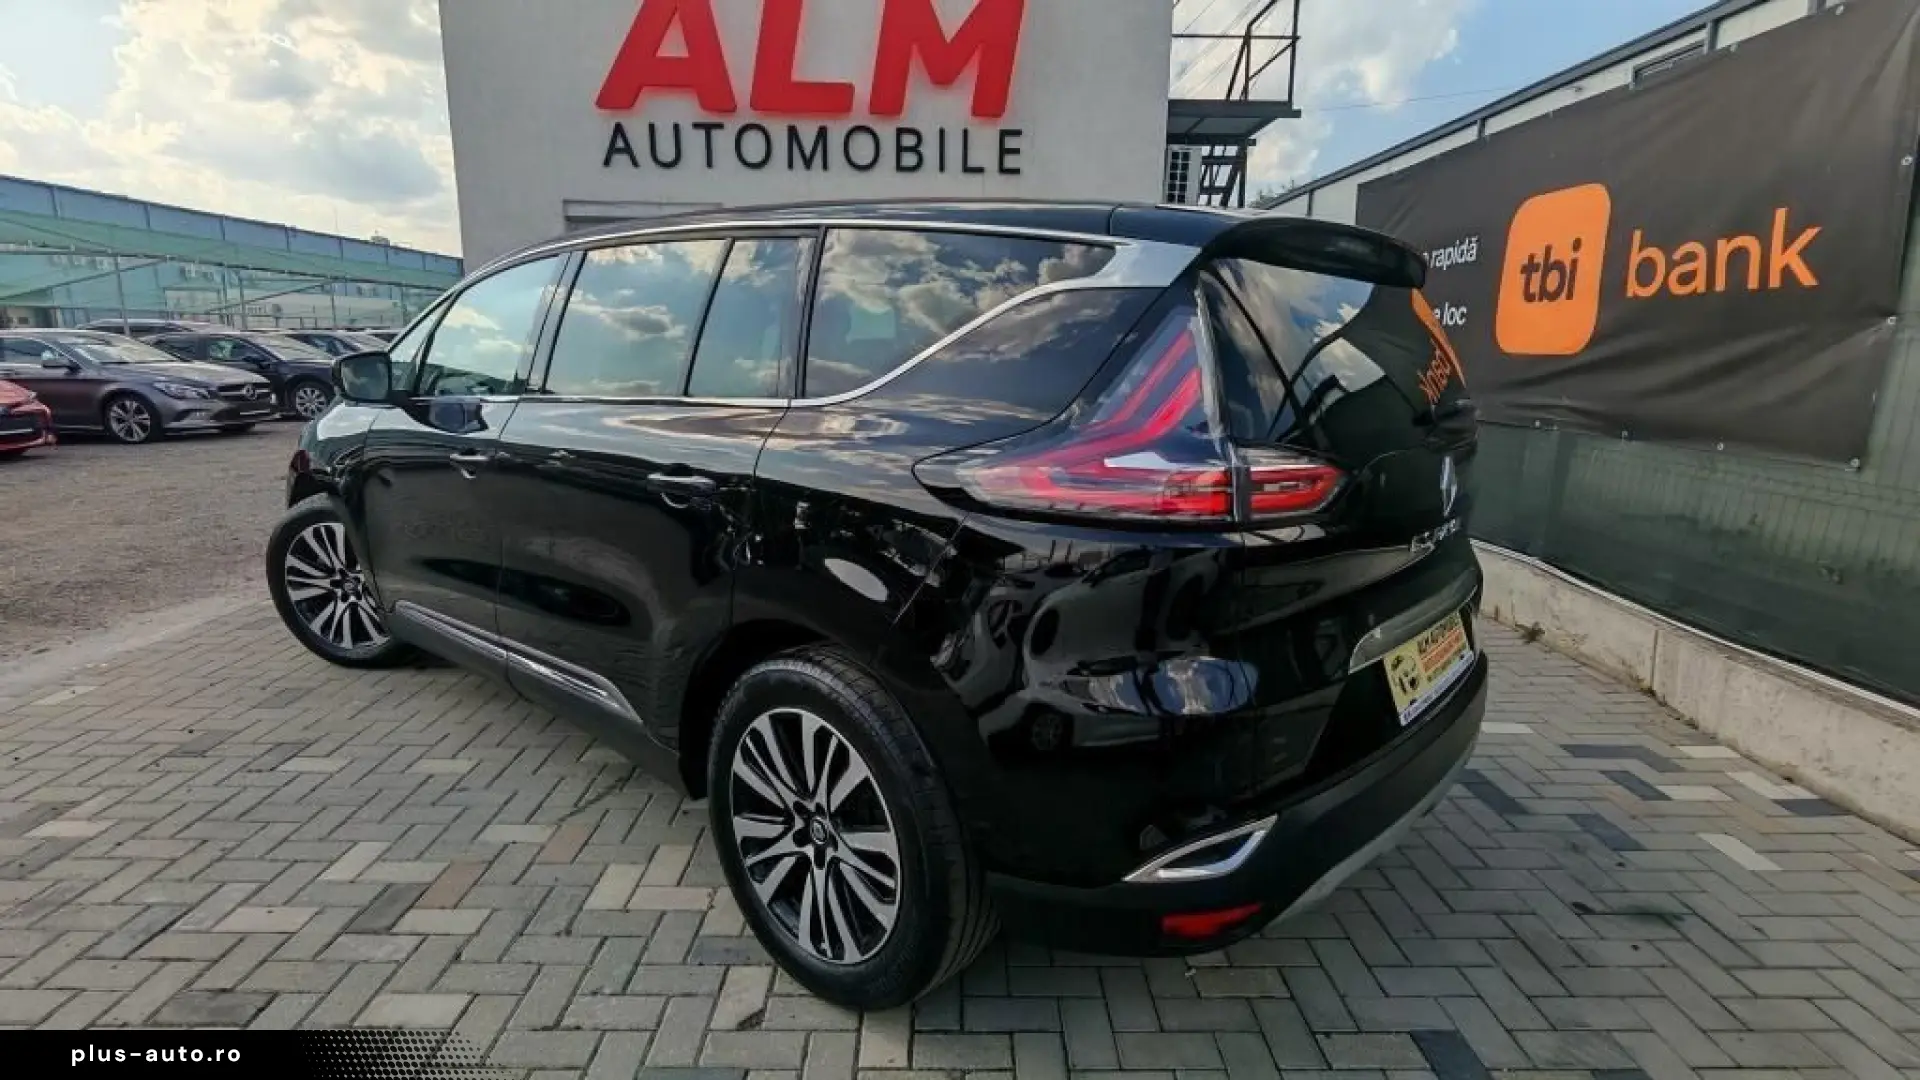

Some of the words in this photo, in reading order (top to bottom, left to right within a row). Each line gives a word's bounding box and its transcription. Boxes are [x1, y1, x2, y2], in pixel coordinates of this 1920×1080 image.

[596, 0, 1025, 117] ALM
[602, 121, 1023, 174] AUTOMOBILE
[1430, 235, 1478, 270] rapidă
[1519, 237, 1582, 303] tbi
[1626, 206, 1822, 297] bank
[1442, 301, 1467, 325] loc
